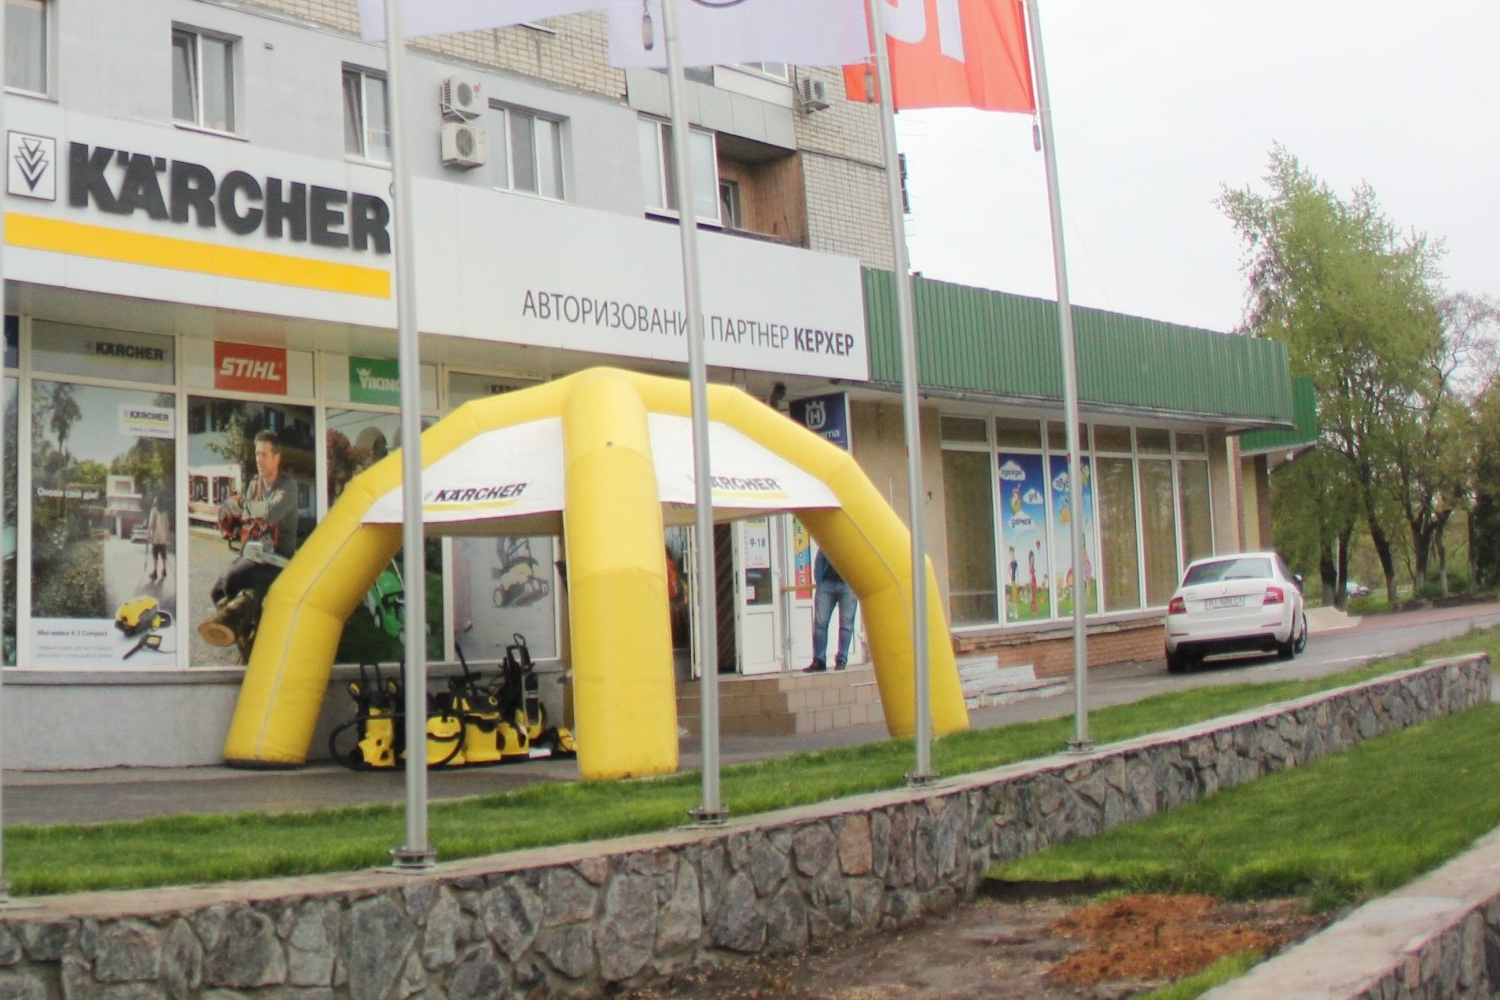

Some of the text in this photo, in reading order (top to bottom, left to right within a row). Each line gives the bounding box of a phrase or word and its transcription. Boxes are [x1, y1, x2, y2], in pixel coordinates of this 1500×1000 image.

[68, 140, 392, 255] KÄRCHER
[523, 289, 855, 357] АВТОРИЗОВАНИ ПАРТНЕР КЕРХЕР
[219, 356, 282, 382] STIHL
[434, 481, 528, 503] KÄRCHER
[749, 538, 766, 548] 9-18
